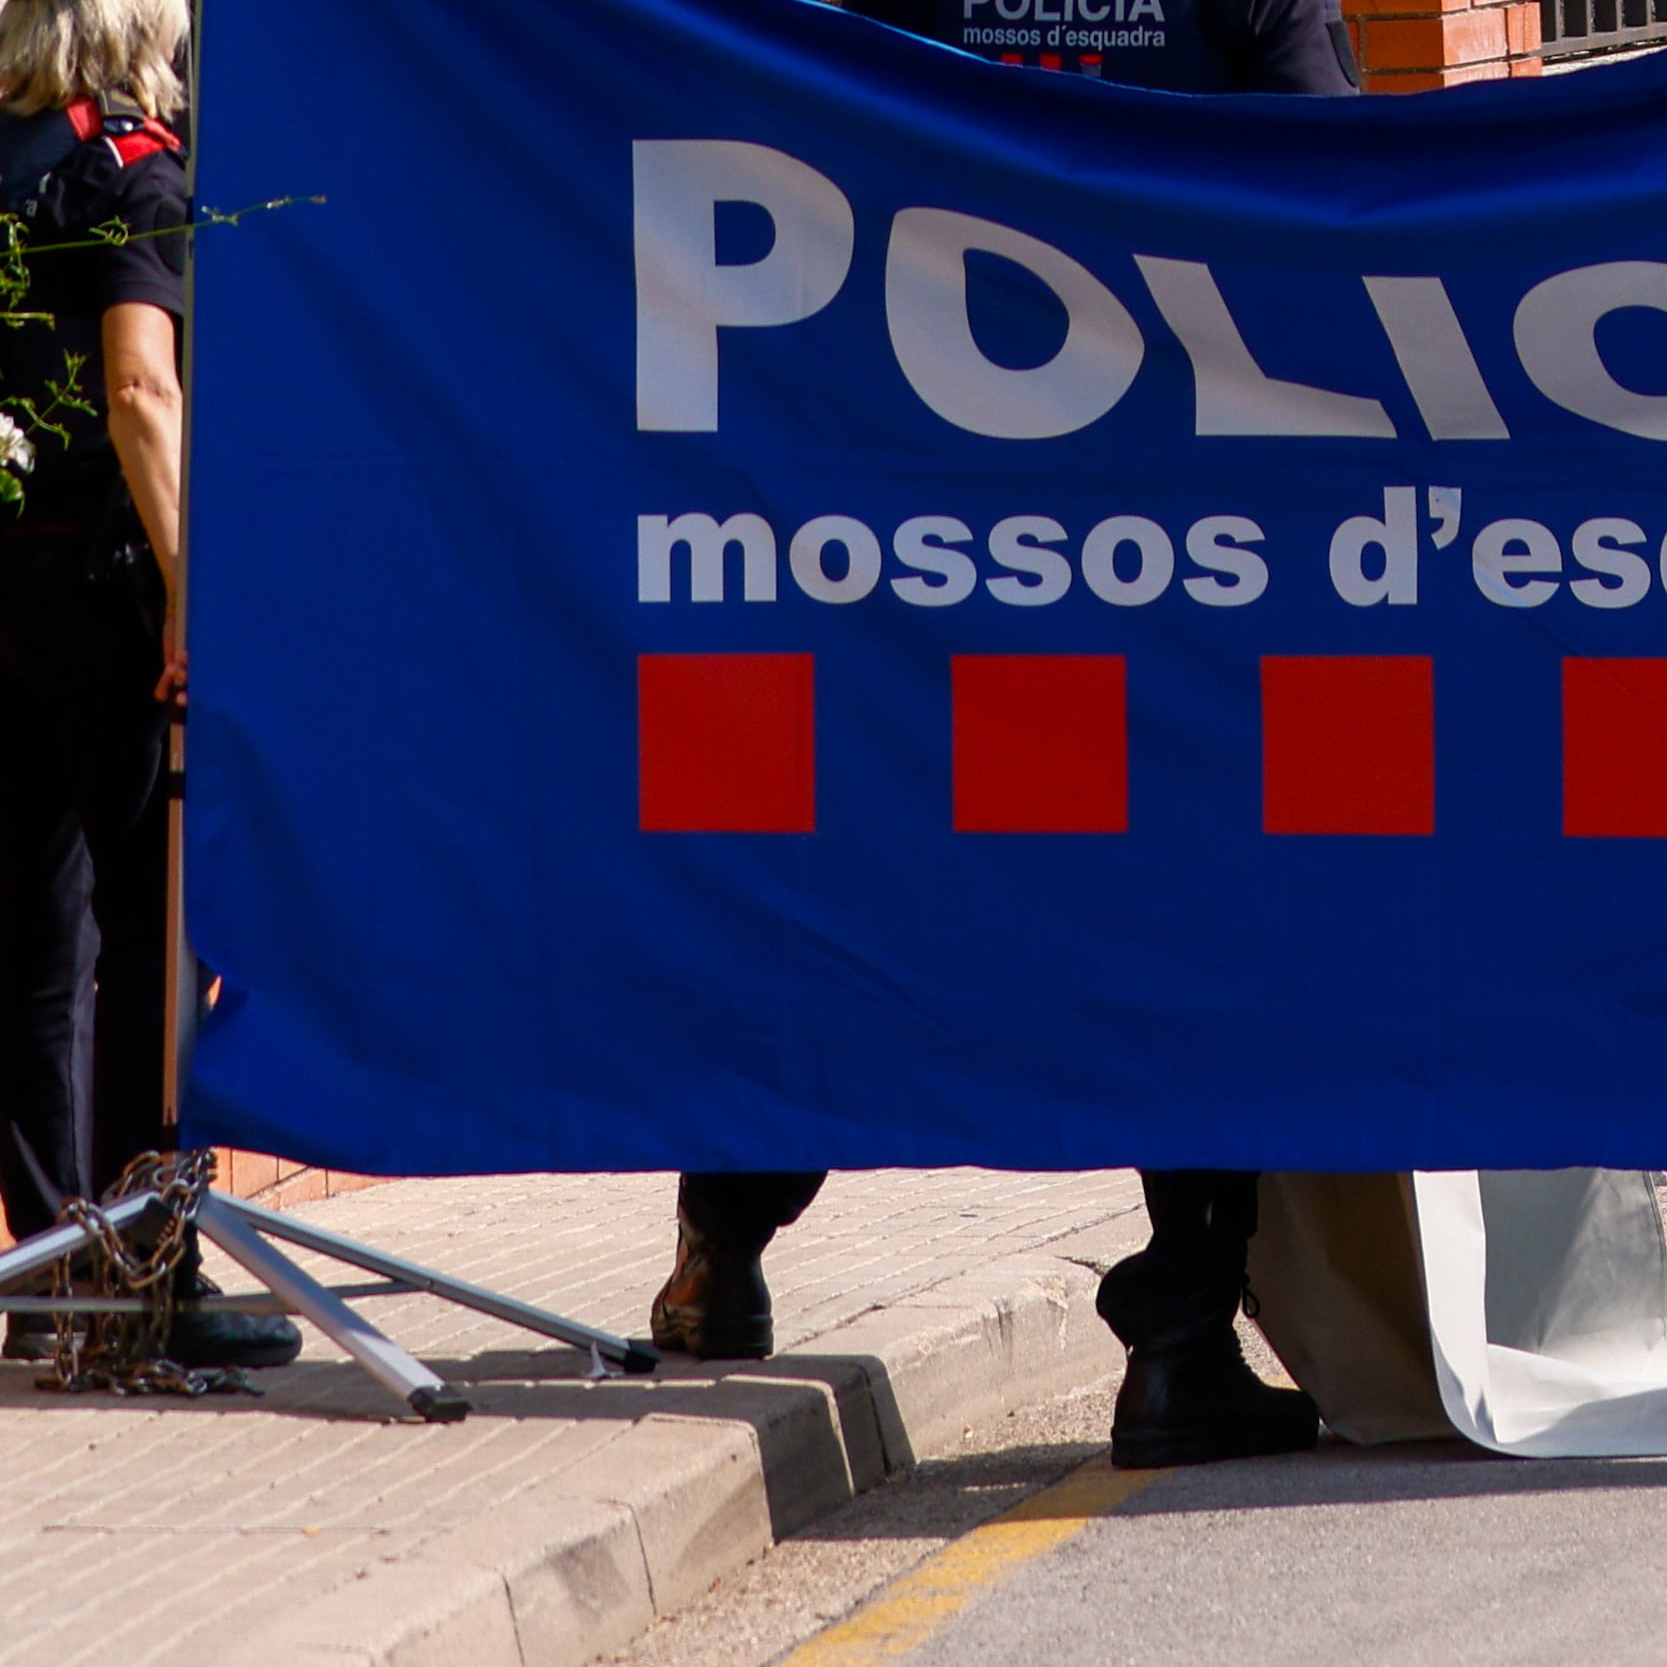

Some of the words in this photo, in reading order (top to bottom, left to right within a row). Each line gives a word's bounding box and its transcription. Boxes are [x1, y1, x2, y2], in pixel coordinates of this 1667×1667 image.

[963, 26, 1041, 46] mossos
[1047, 24, 1166, 51] d'esquadra
[634, 512, 1270, 609] mossos
